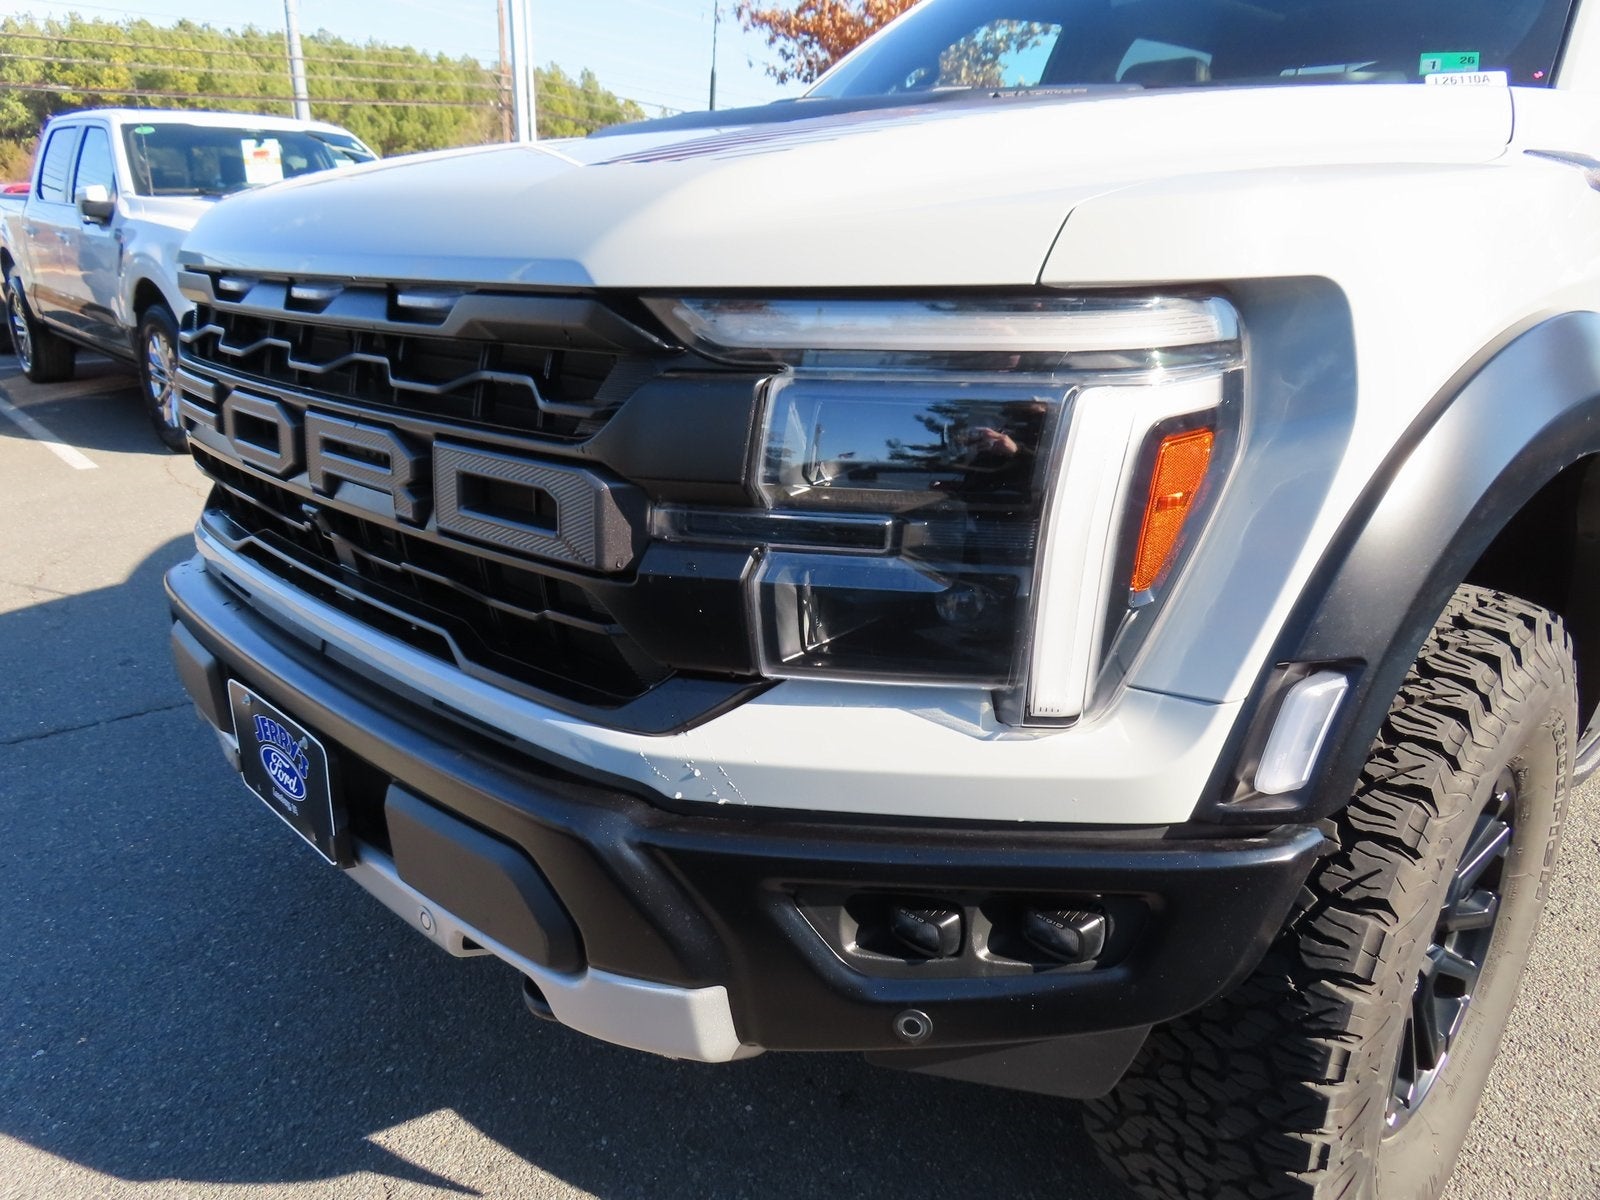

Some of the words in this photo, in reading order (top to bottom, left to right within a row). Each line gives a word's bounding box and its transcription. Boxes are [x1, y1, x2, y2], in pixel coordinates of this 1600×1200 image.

[1460, 57, 1475, 65] 26
[177, 368, 606, 571] FORD
[253, 714, 310, 779] JERRY'S
[269, 751, 298, 794] Ford
